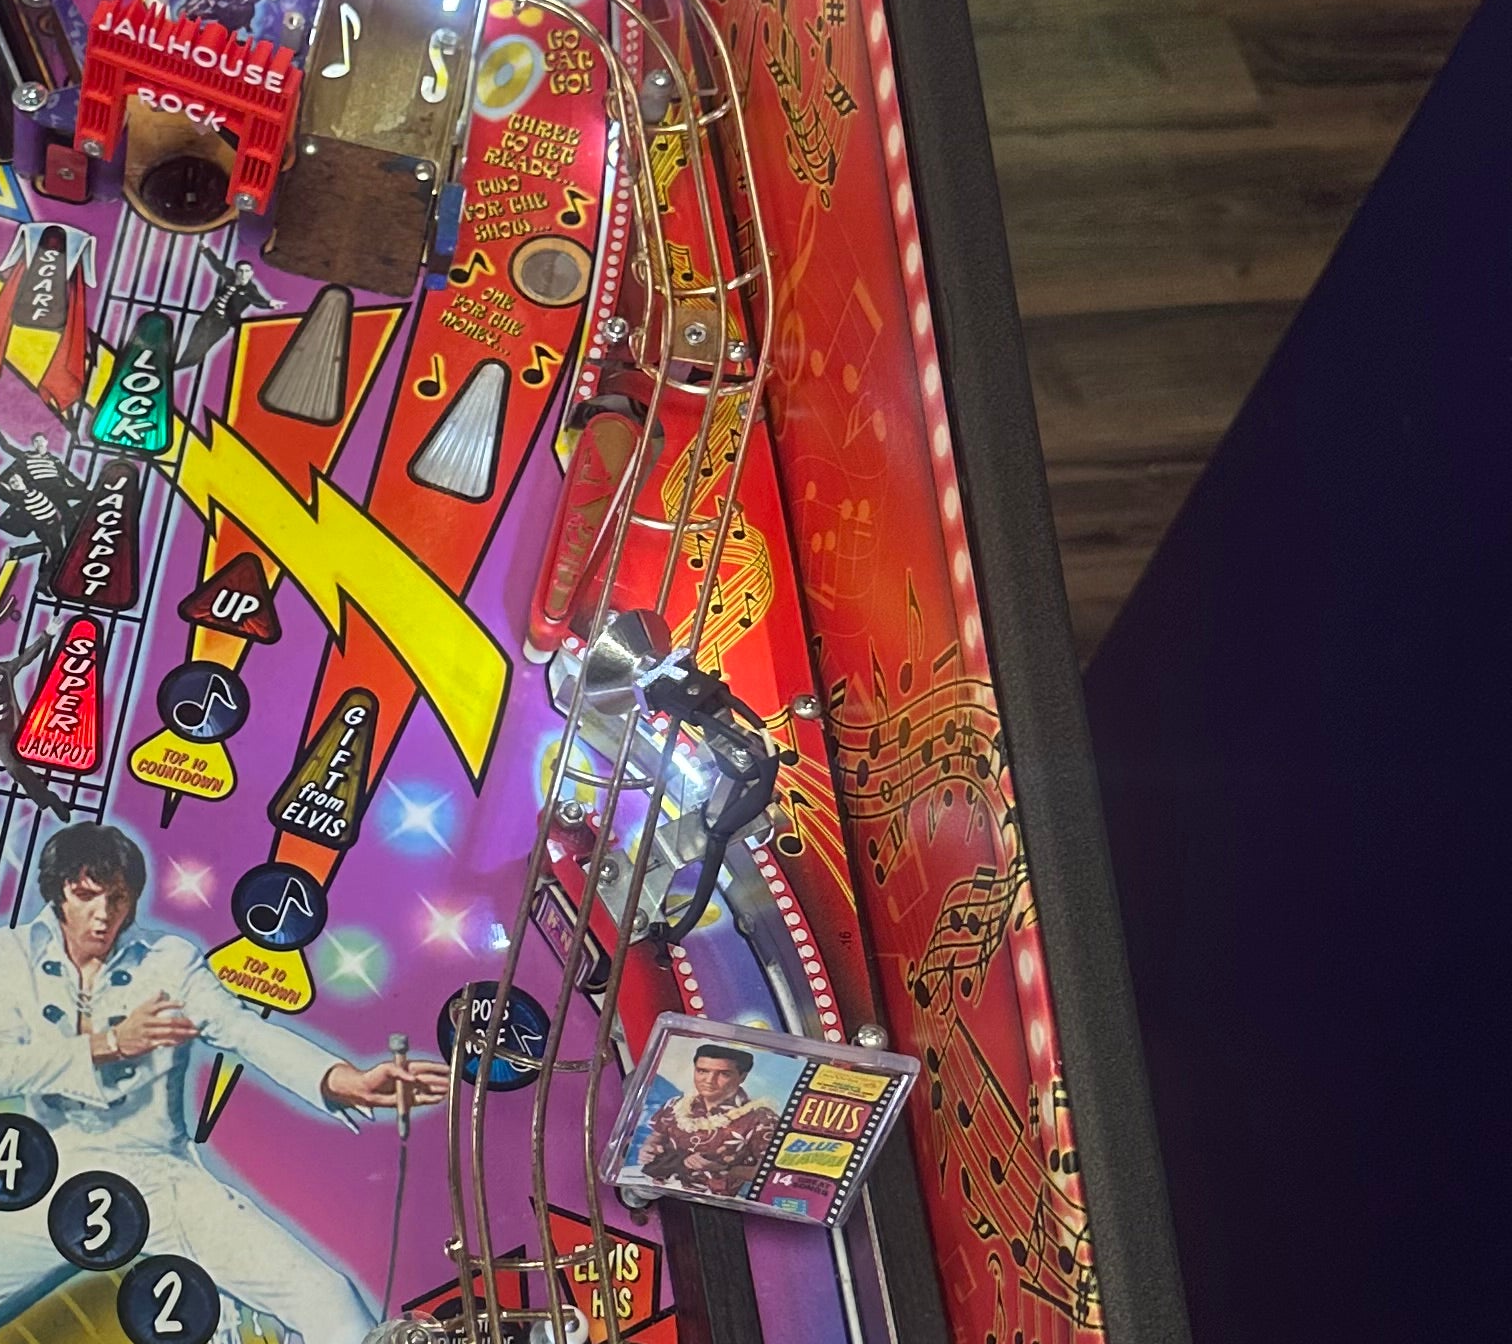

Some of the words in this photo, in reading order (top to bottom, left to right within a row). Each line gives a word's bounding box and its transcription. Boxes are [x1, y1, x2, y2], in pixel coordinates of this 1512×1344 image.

[98, 11, 285, 95] JAILHOUSE
[546, 28, 582, 52] GO
[137, 86, 227, 133] ROCK
[507, 112, 582, 147] THREE
[500, 132, 529, 153] TO
[532, 139, 576, 166] GET
[463, 197, 506, 223] FOR
[508, 192, 550, 215] THE
[31, 249, 61, 321] SCARF
[479, 286, 516, 312] ONE
[110, 348, 162, 441] LOCK
[81, 476, 129, 597] JACKPOT
[210, 588, 261, 624] UP
[46, 638, 96, 734] SUPER
[18, 737, 93, 767] JACKPOT
[162, 748, 189, 767] TOP
[191, 756, 209, 772] 10
[324, 706, 368, 792] GIFT
[136, 757, 226, 795] COUNTDOWN
[297, 781, 346, 813] from
[280, 800, 348, 840] ELVIS
[218, 966, 303, 1006] COUNTDOWN
[241, 954, 272, 977] TOP
[271, 965, 287, 984] 10
[798, 1097, 865, 1134] ELVIS
[784, 1138, 843, 1154] BLUE
[772, 1171, 793, 1187] 14
[84, 1187, 113, 1252] 3
[151, 1269, 184, 1335] 2
